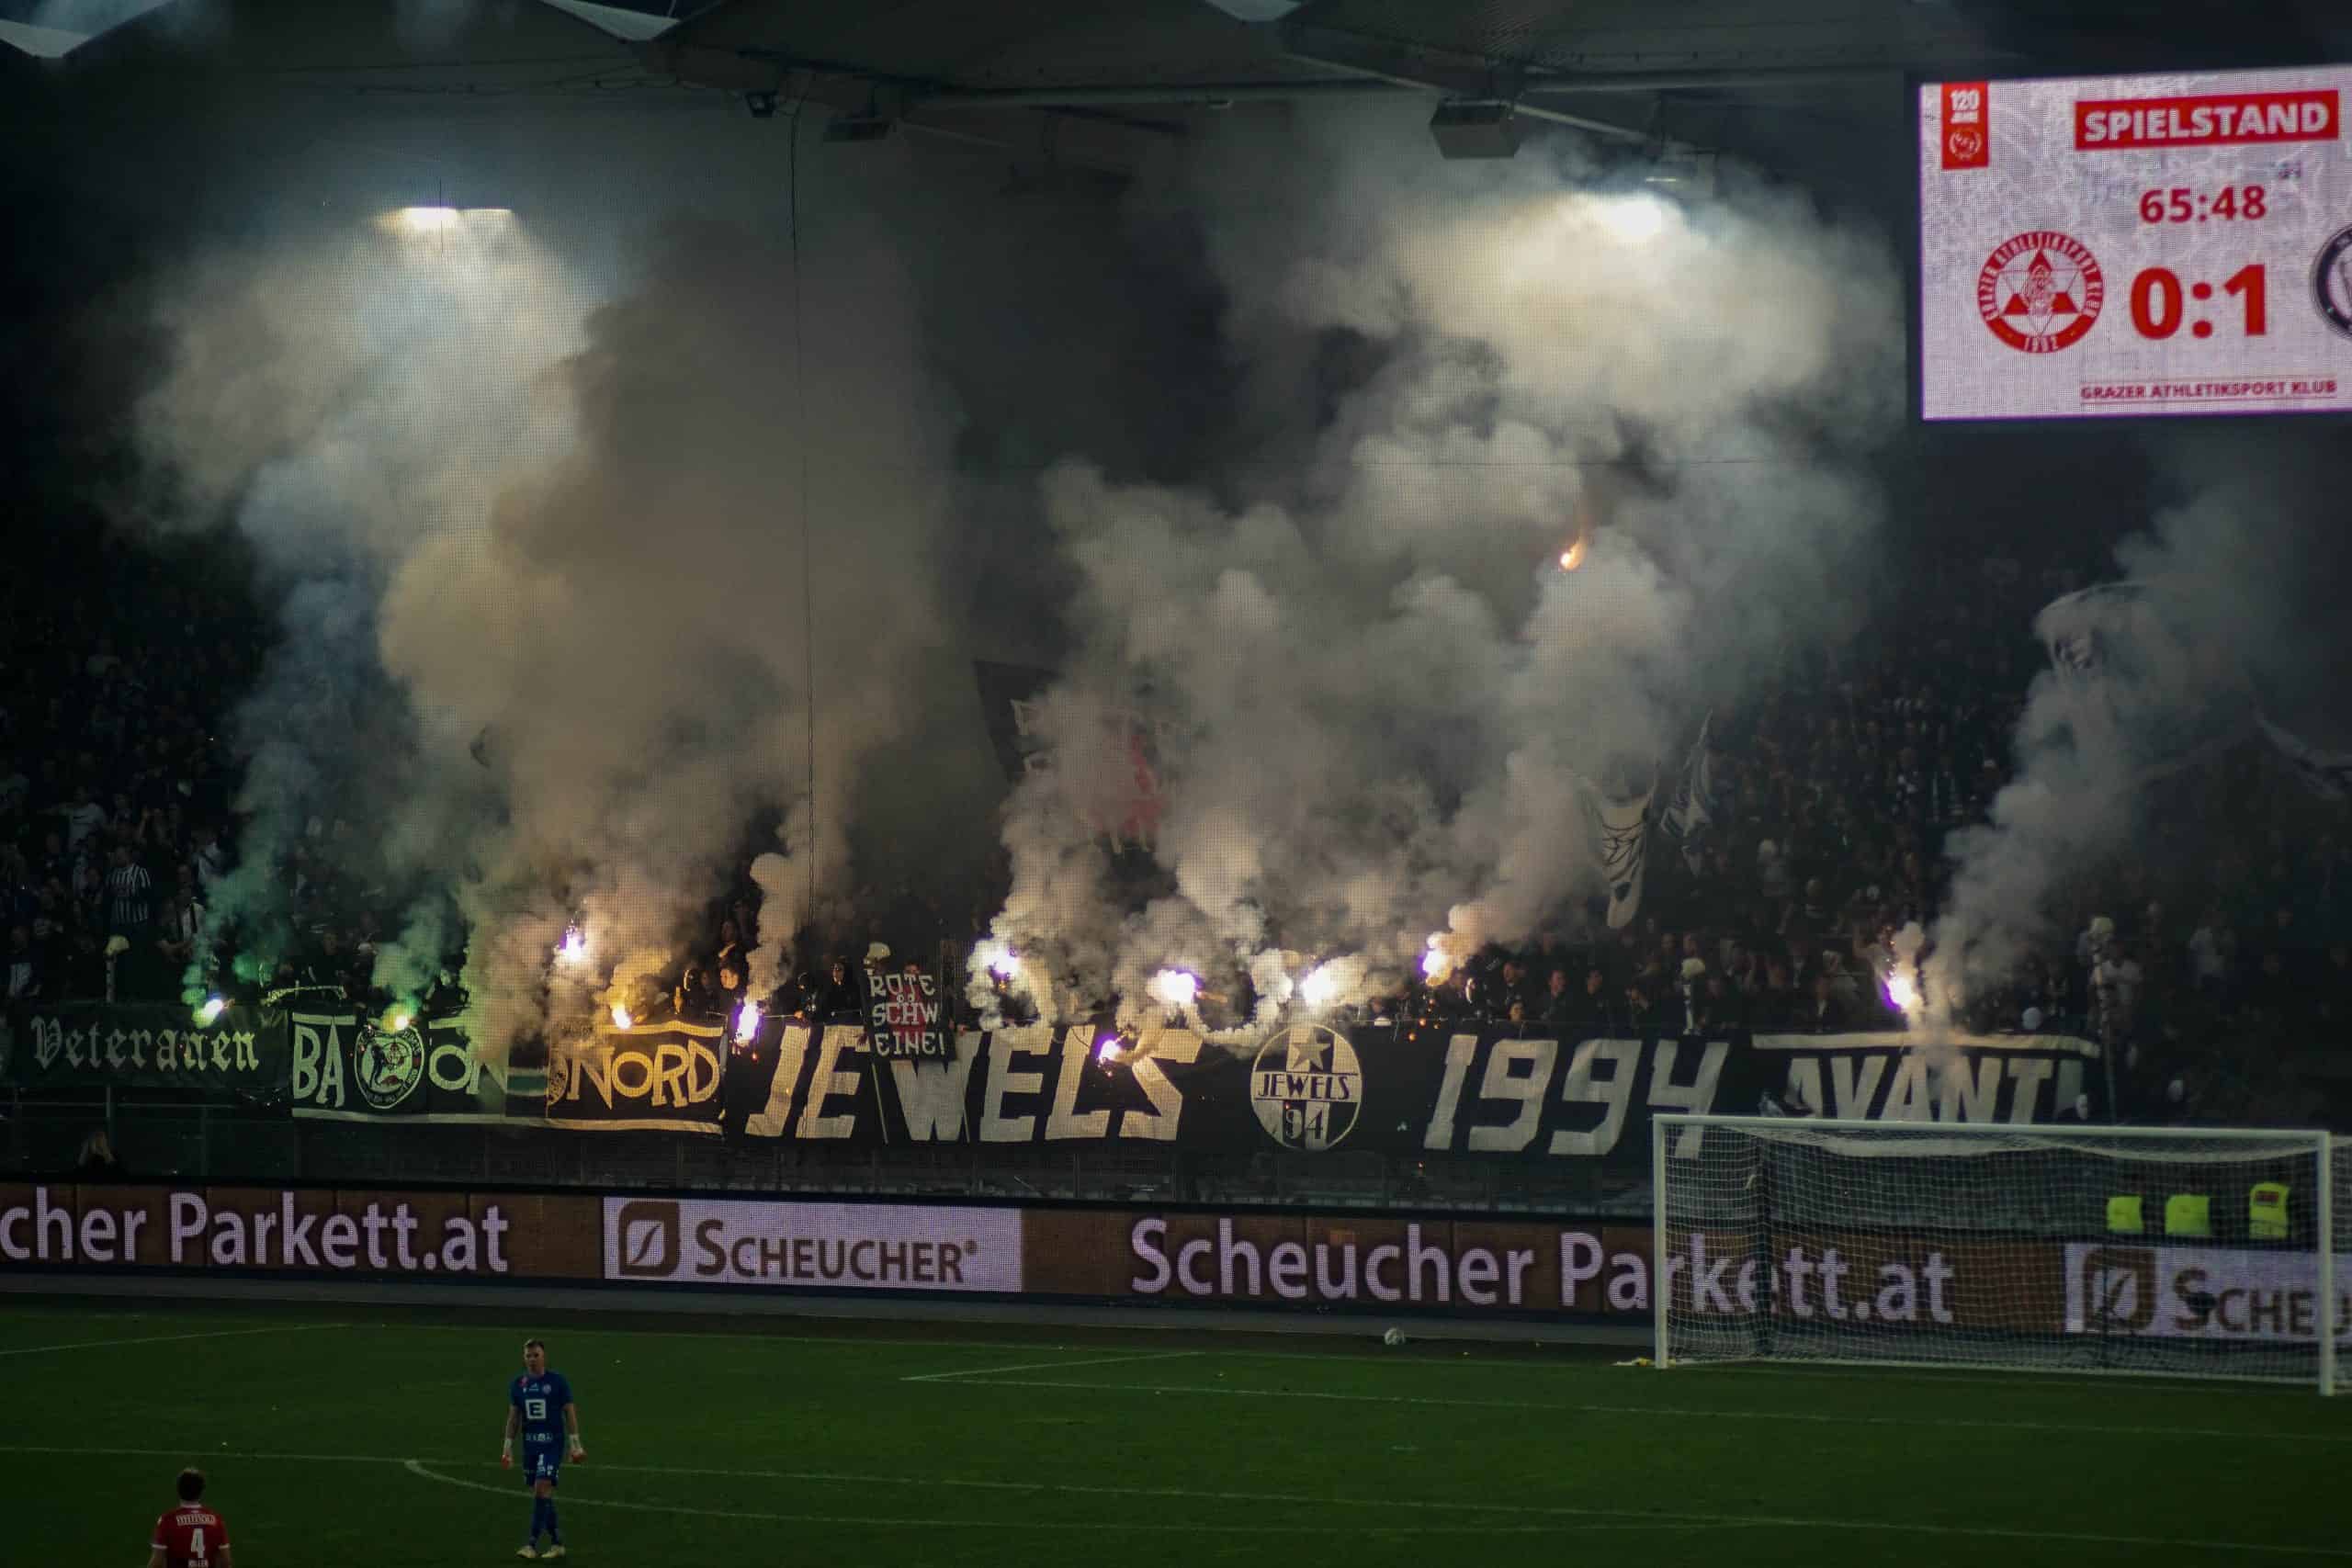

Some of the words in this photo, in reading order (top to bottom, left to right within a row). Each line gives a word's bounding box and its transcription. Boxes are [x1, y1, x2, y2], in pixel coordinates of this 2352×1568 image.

[2084, 102, 2330, 142] SPIELSTAND
[2140, 186, 2267, 223] 65:48
[2130, 264, 2267, 340] 0:1
[2080, 383, 2146, 399] GRAZER
[2150, 381, 2286, 398] ATHLETIKSPORT
[2291, 379, 2335, 395] KLUB
[30, 1014, 259, 1072] Veteranen
[745, 1024, 1203, 1141] JEWELS
[1423, 1034, 1729, 1159] 1994
[1258, 1073, 1351, 1100] JEWELS
[170, 1191, 508, 1272] Parkett.at
[1131, 1218, 1533, 1304] Scheucher
[191, 1528, 206, 1559] 4
